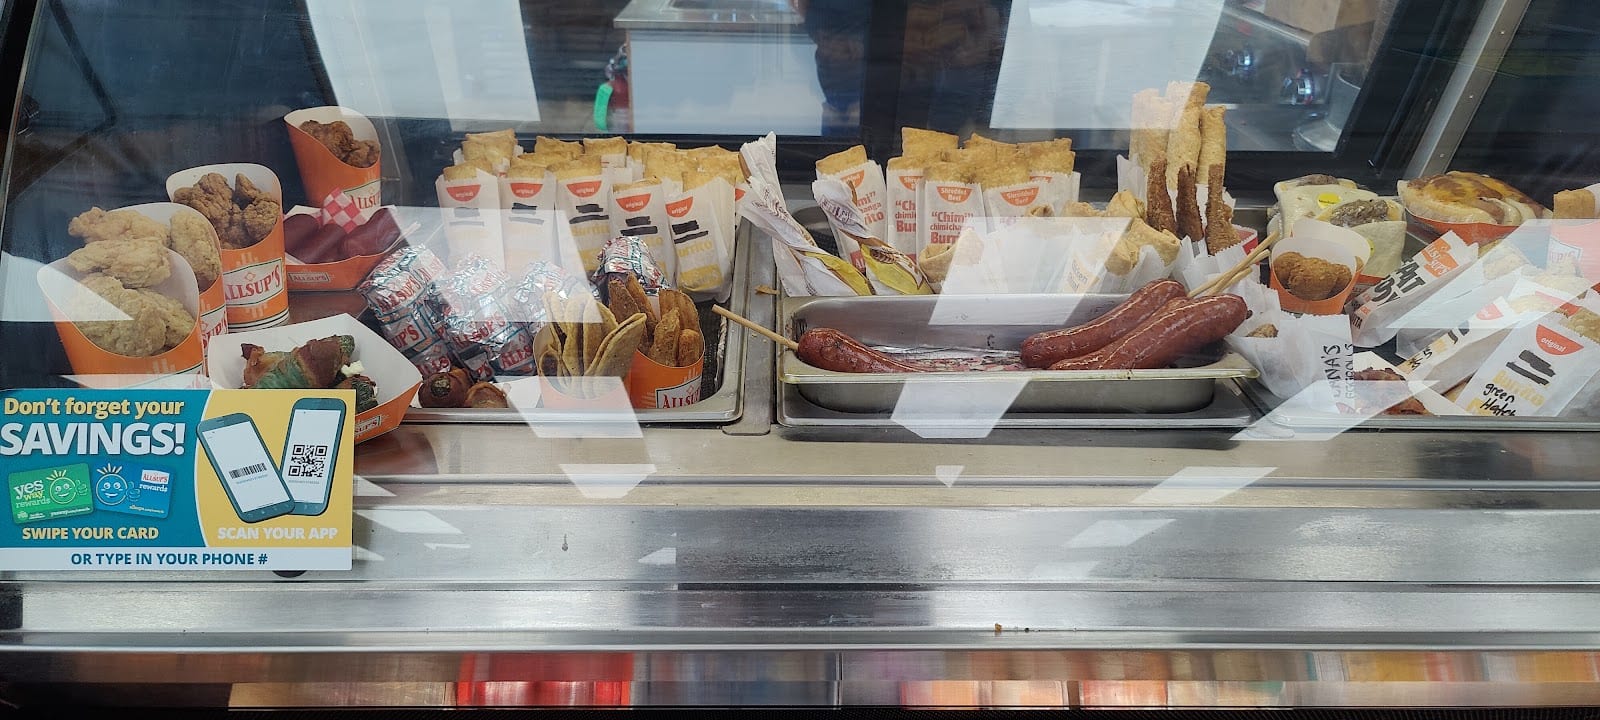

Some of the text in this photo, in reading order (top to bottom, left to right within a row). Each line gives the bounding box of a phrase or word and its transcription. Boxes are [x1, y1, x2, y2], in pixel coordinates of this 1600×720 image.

[224, 265, 281, 301] ALLSUP'S
[1540, 337, 1567, 353] original
[1483, 383, 1515, 403] green
[4, 397, 185, 420] Don't forget your
[0, 422, 186, 456] SAVINGS!
[13, 479, 45, 500] yes
[138, 483, 169, 493] rewards
[15, 496, 51, 509] rewards
[23, 489, 44, 502] way
[22, 527, 159, 540] SWIPE YOUR CARD
[217, 527, 338, 540] SCAN YOUR APP
[71, 553, 268, 565] OR TYPE IN YOUR PHONE #
